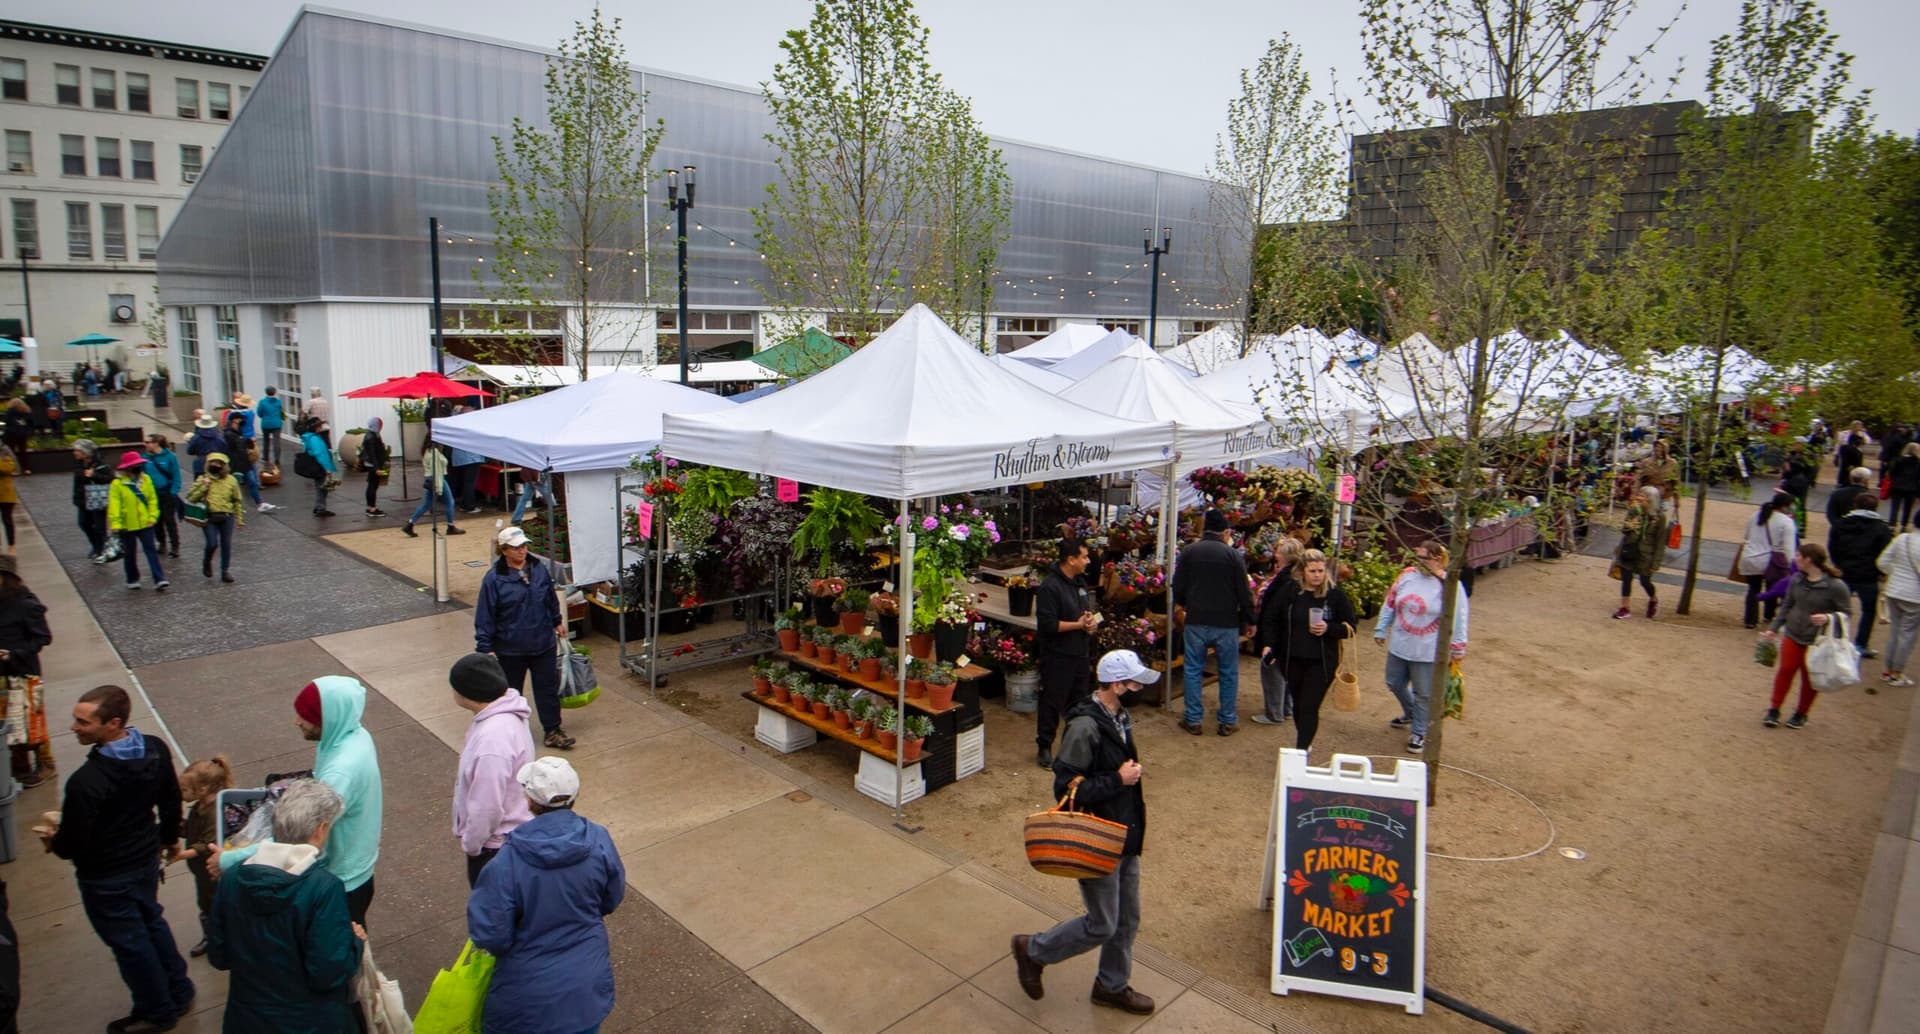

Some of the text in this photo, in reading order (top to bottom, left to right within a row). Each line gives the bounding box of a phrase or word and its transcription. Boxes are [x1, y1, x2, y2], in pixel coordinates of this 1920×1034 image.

[993, 438, 1113, 480] Rhythm & Blooms
[1223, 424, 1265, 457] Rhythm
[1303, 846, 1399, 883] FARMERS
[1303, 899, 1394, 938] MARKET
